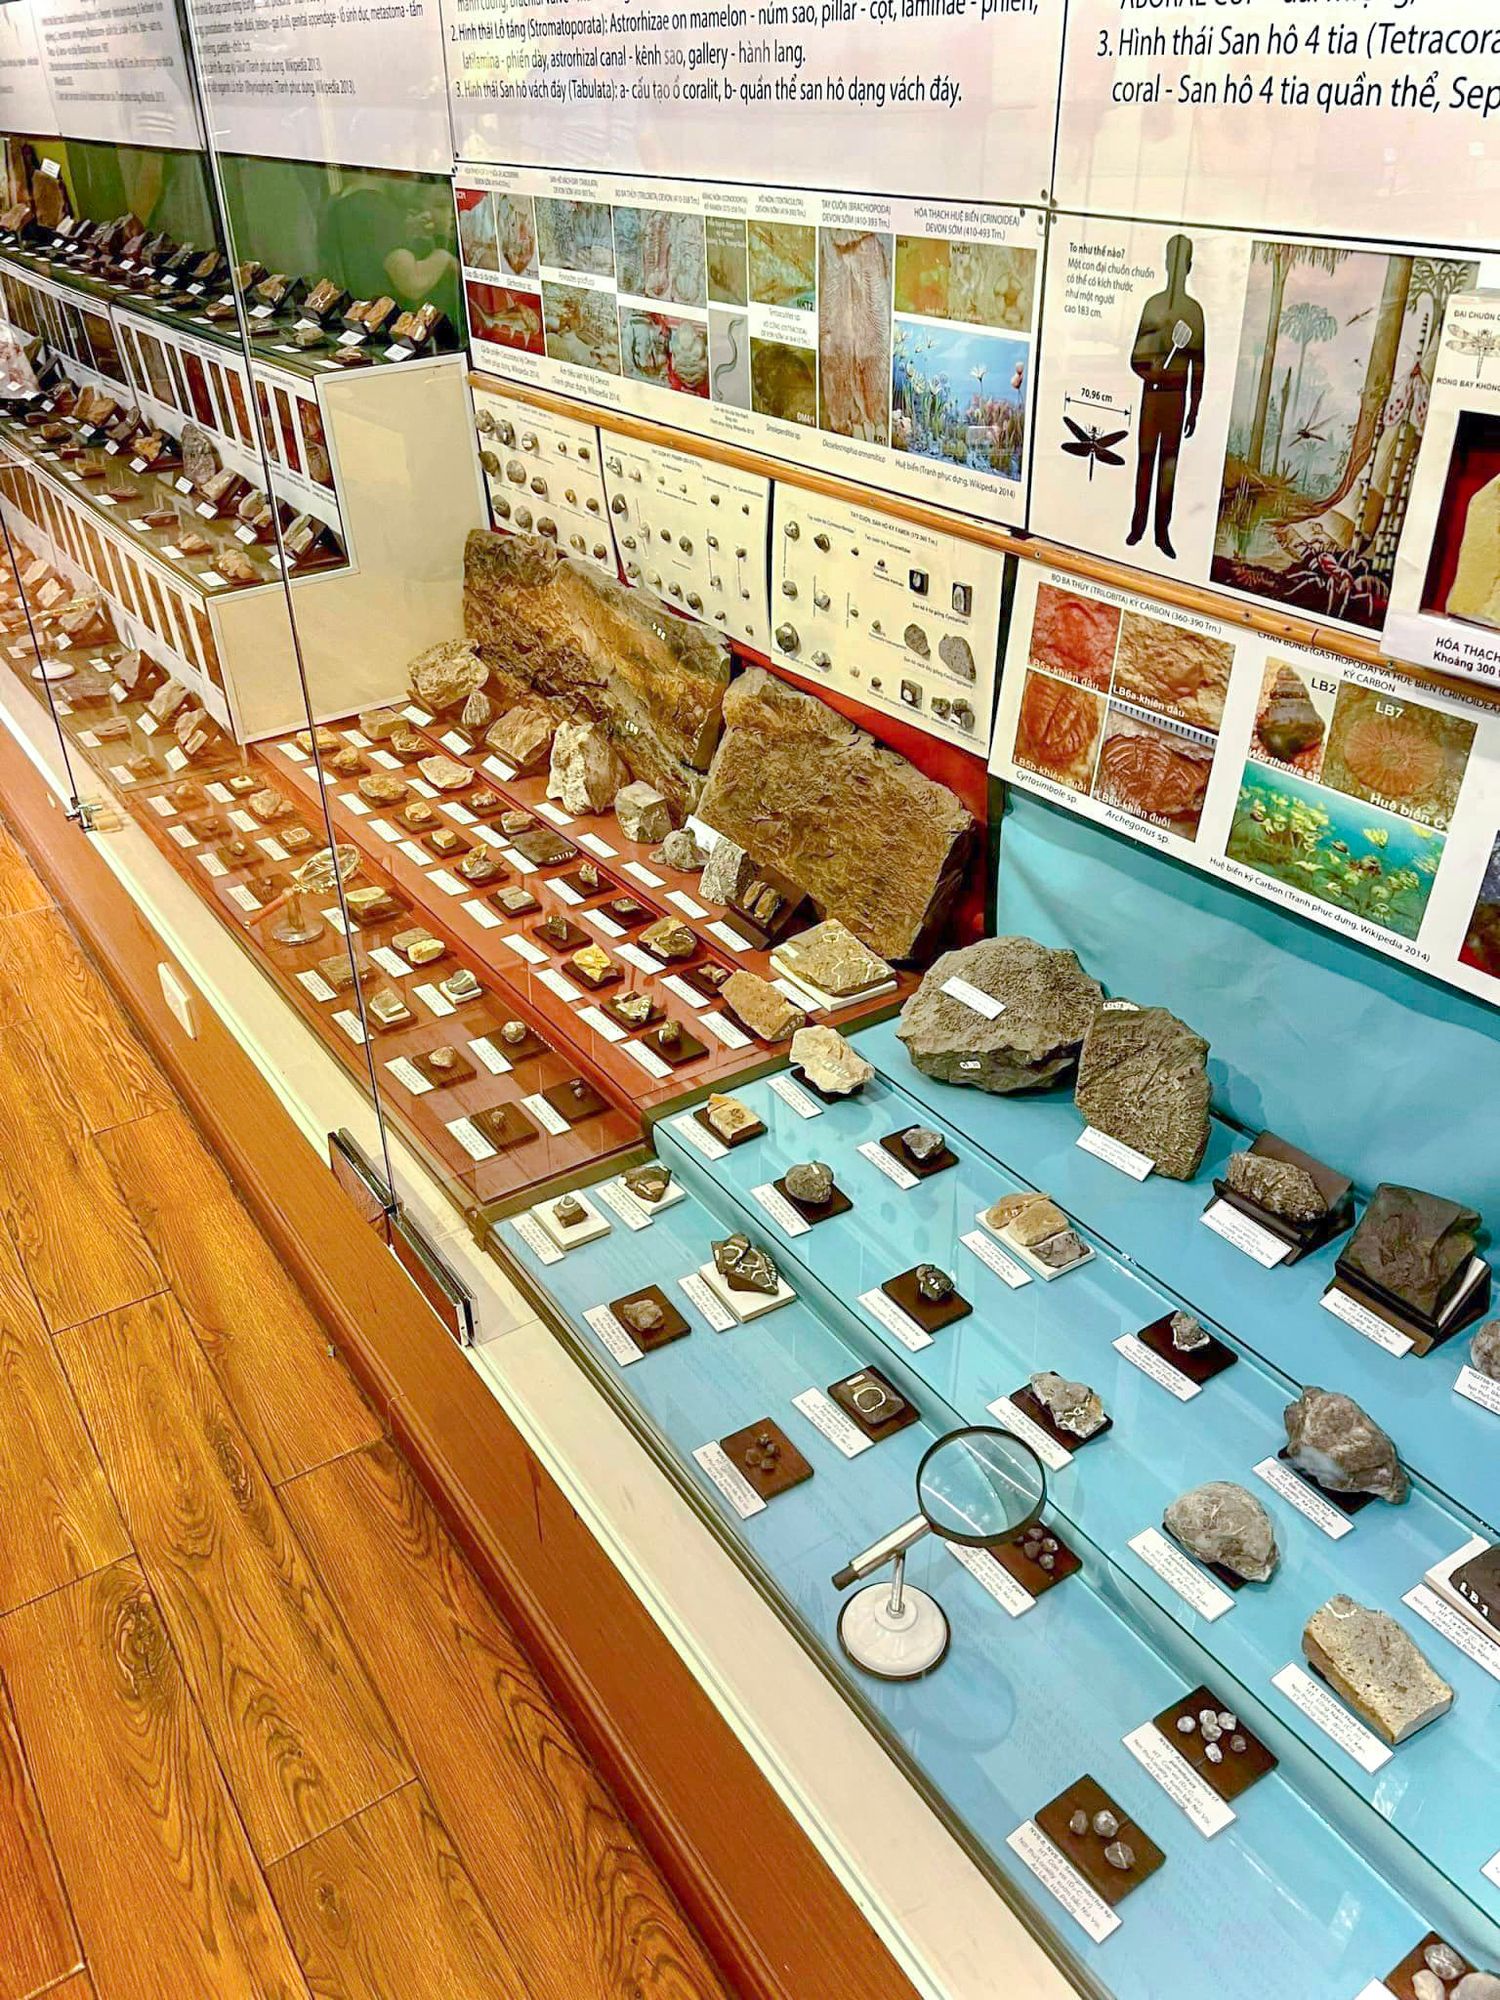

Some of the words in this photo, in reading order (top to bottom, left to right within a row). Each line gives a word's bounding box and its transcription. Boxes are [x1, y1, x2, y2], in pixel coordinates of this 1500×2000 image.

[371, 4, 405, 21] metastoma
[451, 25, 458, 41] 2.
[528, 14, 607, 39] (Stromatoporata):
[610, 11, 669, 32] Astrorhizae
[672, 13, 686, 30] on
[690, 4, 746, 29] mamelon
[759, 1, 788, 25] núm
[792, 5, 818, 26] sao,
[821, 0, 857, 28] pillar
[870, 0, 896, 24] cột,
[901, 0, 965, 17] laminae
[1097, 29, 1113, 57] 3.
[1119, 26, 1166, 56] Hình
[1173, 25, 1213, 56] thái
[1219, 25, 1260, 55] San
[1267, 23, 1298, 55] hô
[1305, 24, 1320, 55] 4
[1328, 24, 1358, 55] tia
[532, 49, 550, 73] dày,
[551, 46, 598, 67] astrorhizal
[600, 45, 626, 66] canal
[635, 44, 661, 66] kênh
[664, 50, 686, 67] sao,
[688, 42, 728, 70] gallery
[739, 40, 770, 63] hành
[774, 39, 806, 68] lang.
[456, 81, 464, 97] 3.
[500, 80, 515, 97] San
[516, 79, 528, 97] hô
[529, 78, 549, 98] vách
[550, 78, 566, 103] đáy
[568, 79, 618, 100] (Tabulata):
[632, 75, 650, 99] cấu
[653, 81, 670, 103] tạo
[683, 77, 721, 102] coralit,
[724, 78, 737, 99] b-
[775, 74, 797, 100] thể
[800, 81, 823, 100] san
[827, 75, 844, 100] hô
[849, 76, 885, 107] dạng
[890, 75, 925, 101] vách
[930, 75, 962, 108] đáy.
[1112, 73, 1161, 103] coral
[1178, 74, 1217, 104] San
[1224, 73, 1253, 104] hô
[1259, 75, 1273, 104] 4
[1281, 75, 1309, 105] tia
[1317, 71, 1382, 114] quần
[1391, 70, 1441, 114] thể,
[1449, 76, 1500, 118] Sep
[848, 201, 892, 215] (BRACHIOPODA)
[914, 207, 928, 218] HÓA
[928, 209, 949, 223] THẠCH
[980, 213, 1021, 227] (CRINOIDEA)
[925, 222, 948, 234] DEVON
[963, 226, 990, 239] (410-493
[1069, 242, 1078, 253] To
[1078, 243, 1093, 255] như
[1107, 248, 1125, 259] nào?
[1067, 258, 1081, 270] Một
[1082, 261, 1095, 272] con
[1096, 261, 1107, 274] đại
[1066, 274, 1075, 284] có
[1088, 275, 1096, 286] có
[1097, 276, 1112, 290] kích
[1065, 287, 1079, 299] như
[1080, 290, 1094, 302] một
[1064, 304, 1076, 314] cao
[1078, 305, 1089, 316] 183
[1460, 379, 1475, 388] BAY
[1081, 387, 1101, 401] 70,96
[1101, 393, 1113, 403] cm
[969, 477, 998, 495] Wikipedia
[998, 487, 1016, 500] 2014)
[1061, 576, 1071, 587] BA
[1090, 585, 1129, 605] (TRILOBITA)
[1140, 600, 1170, 618] CARBON
[1171, 610, 1203, 628] (360-390
[1436, 636, 1460, 652] HÓA
[1433, 650, 1474, 672] Khoảng
[1477, 662, 1495, 676] 300
[1311, 677, 1337, 694] LB2
[1356, 674, 1396, 692] CARBON
[1113, 685, 1165, 710] LB6a-khiên
[1375, 701, 1404, 719] LB7
[1306, 770, 1324, 785] sp.
[1370, 792, 1397, 813] Huệ
[1105, 809, 1156, 840] Archegonus
[1209, 856, 1226, 872] Huệ
[1254, 876, 1284, 897] Carbon
[1284, 889, 1311, 909] (Tranh
[1311, 901, 1333, 921] phục
[1360, 923, 1404, 951] Wikipedia
[1404, 943, 1431, 963] 2014)
